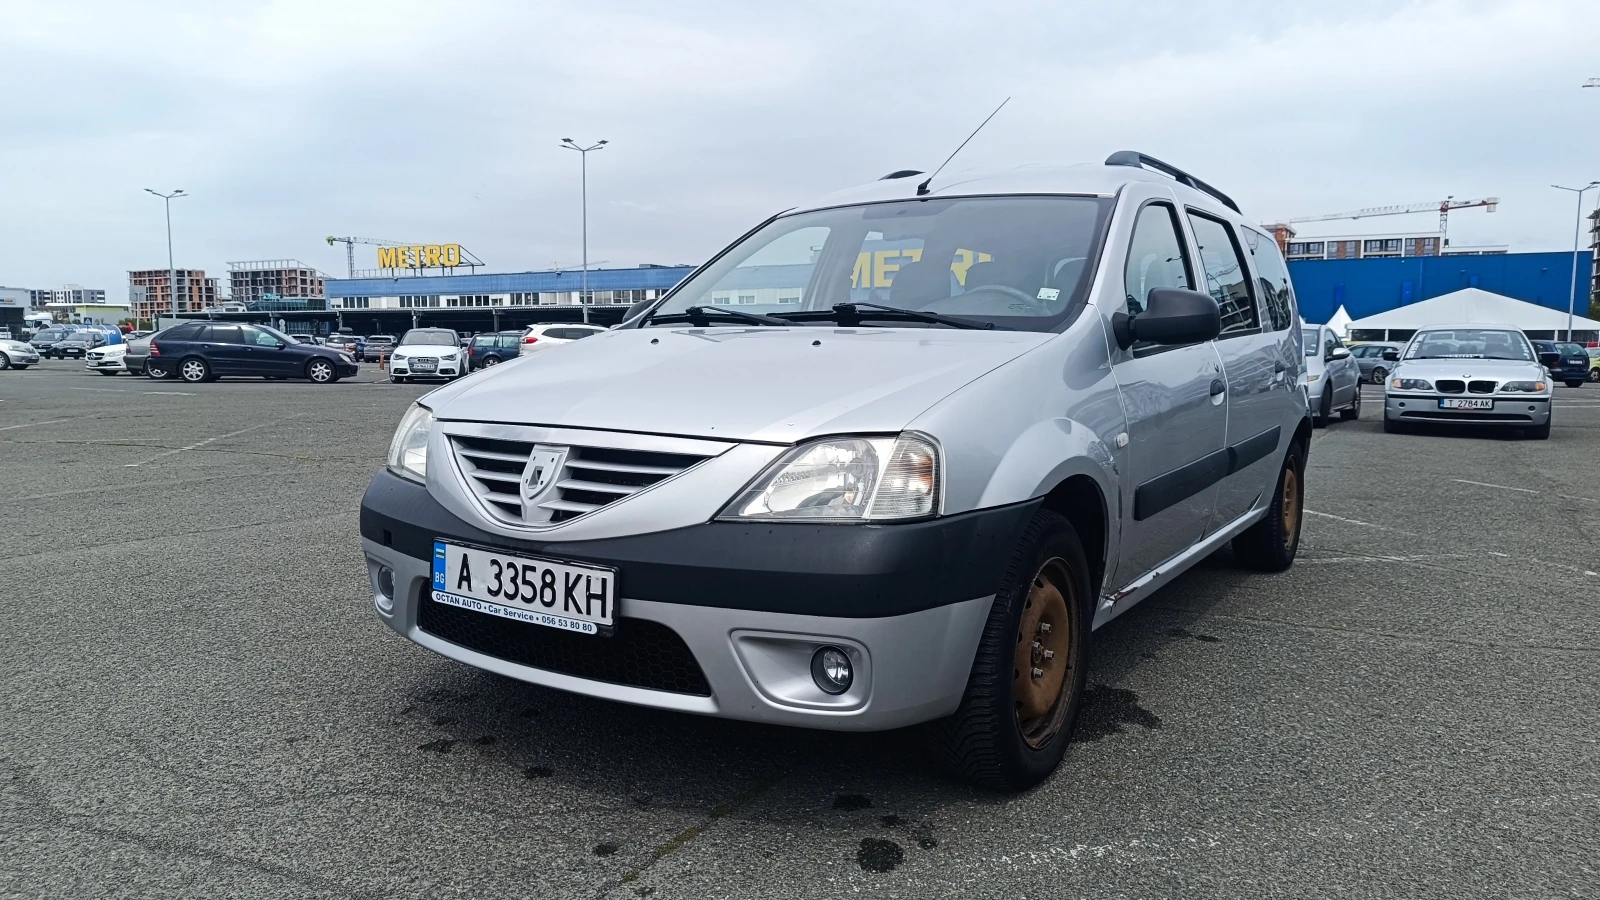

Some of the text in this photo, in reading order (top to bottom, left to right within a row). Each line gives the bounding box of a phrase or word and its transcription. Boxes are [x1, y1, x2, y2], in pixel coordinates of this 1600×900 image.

[377, 244, 460, 269] METRO
[1457, 399, 1478, 408] 2784
[1479, 400, 1491, 408] AK
[434, 571, 445, 584] BG
[457, 552, 608, 619] A 3358 KH
[435, 593, 593, 632] OCTAN AUTO Car Service 056 53 80 80
